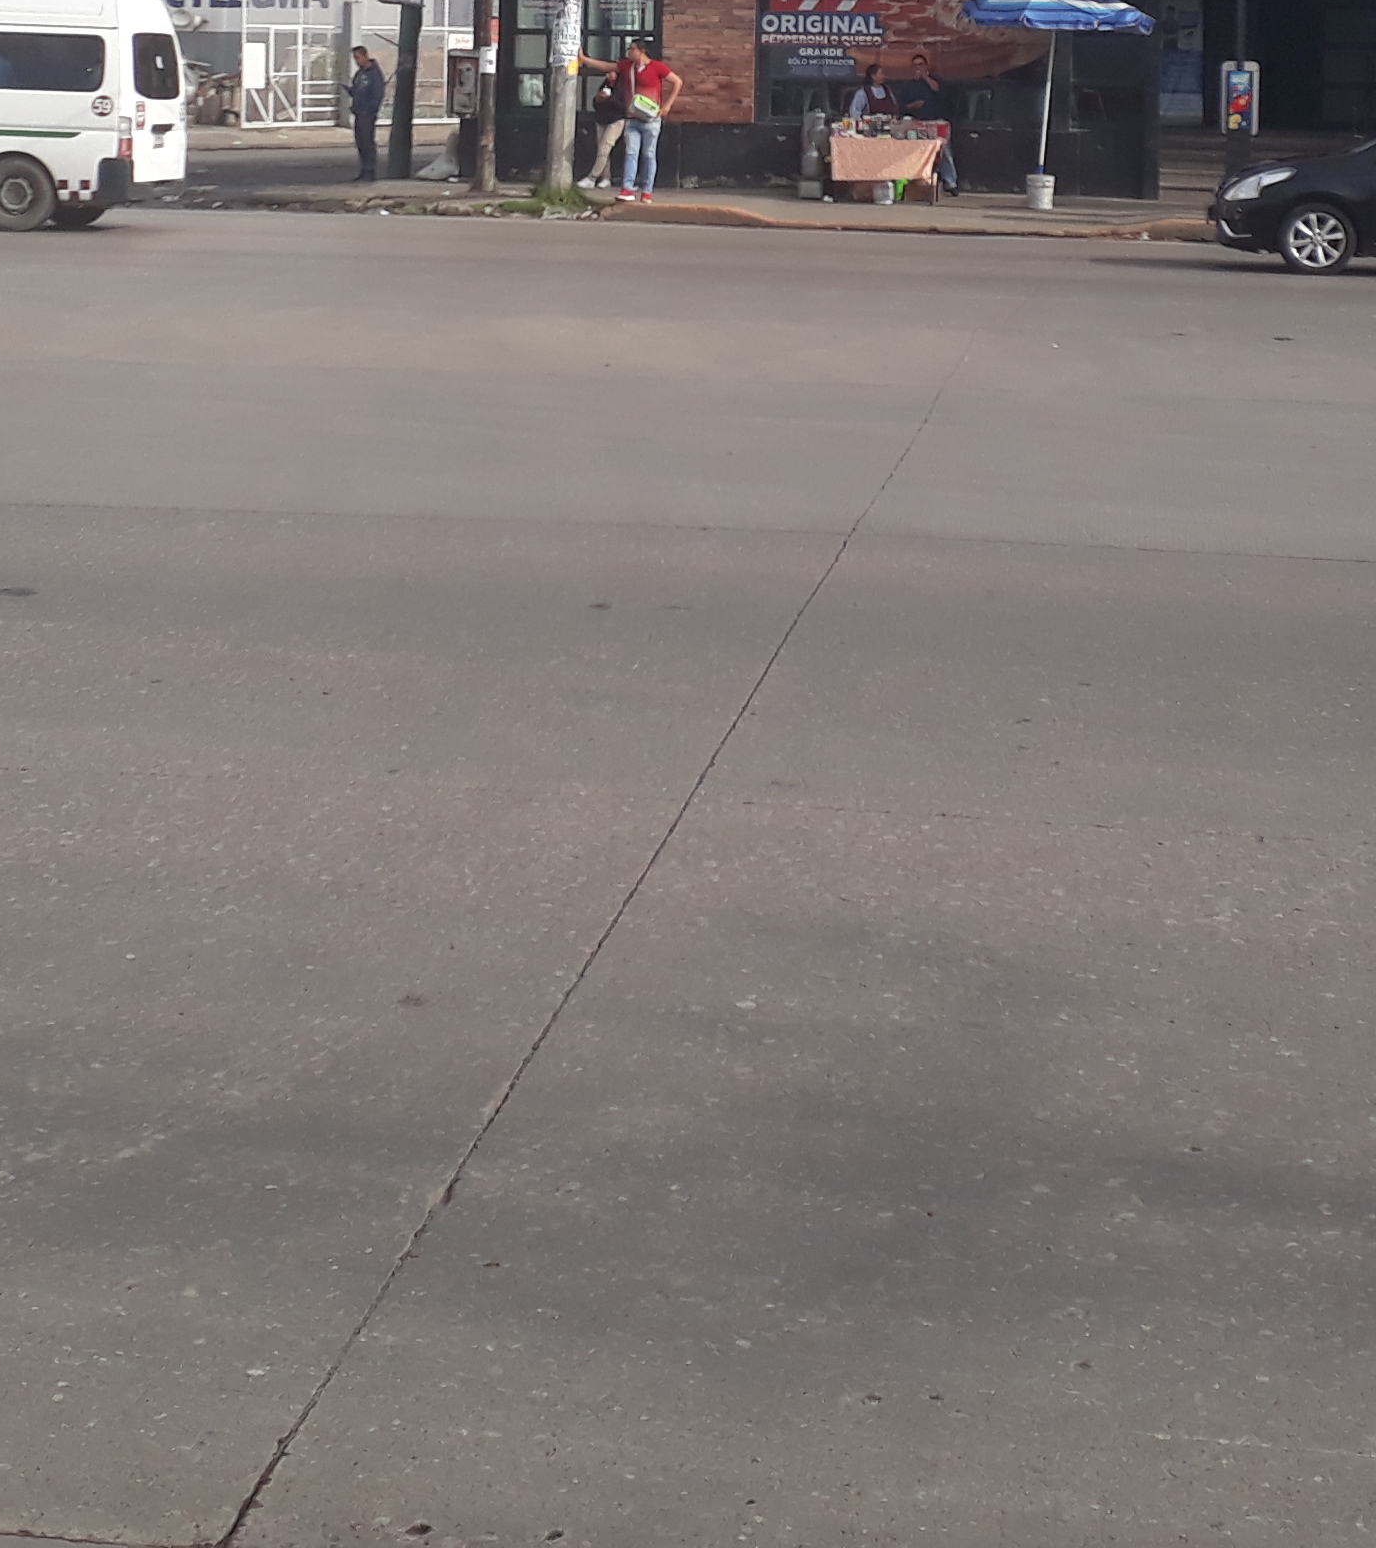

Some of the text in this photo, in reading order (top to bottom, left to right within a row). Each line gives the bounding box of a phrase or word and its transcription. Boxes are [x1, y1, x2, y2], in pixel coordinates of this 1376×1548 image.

[761, 14, 883, 34] ORIGINAL
[761, 33, 828, 45] PEPPERONI
[799, 47, 844, 57] GRANDE
